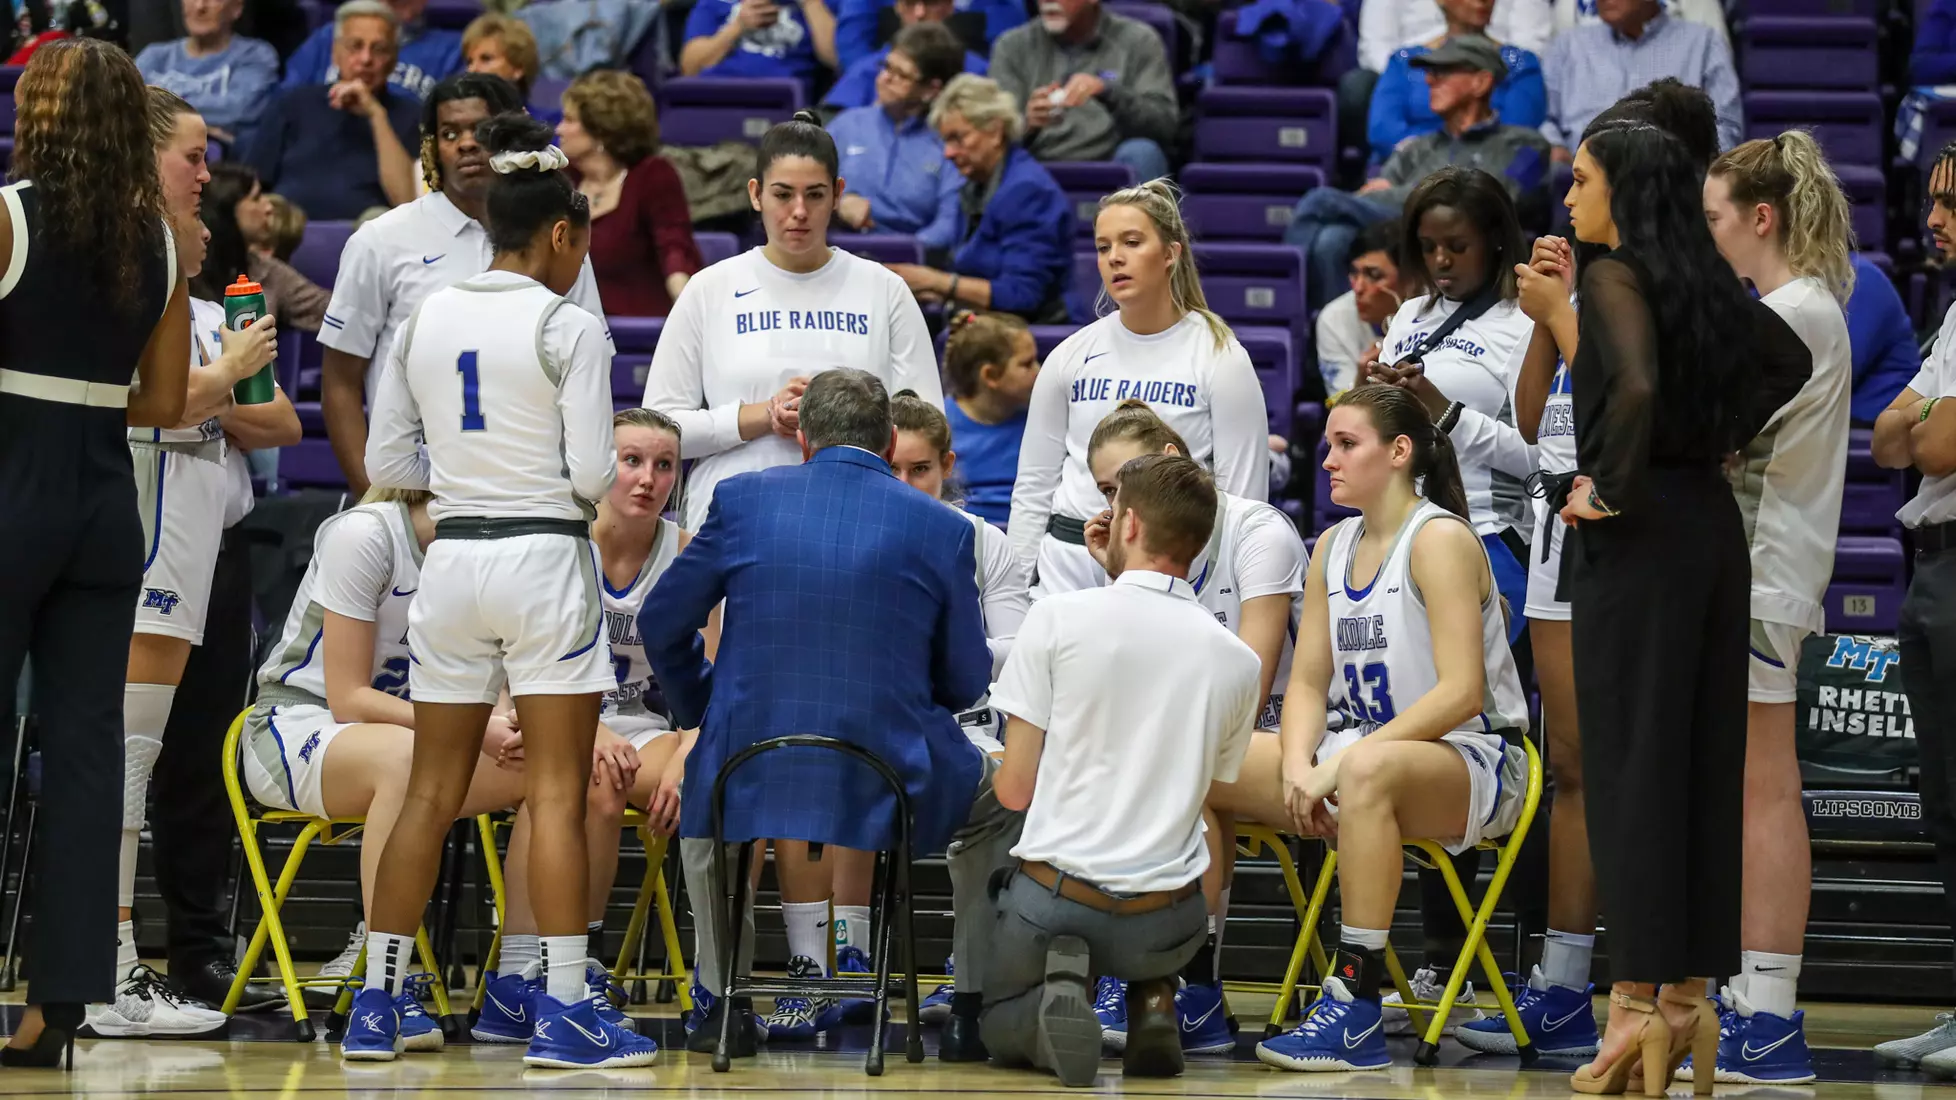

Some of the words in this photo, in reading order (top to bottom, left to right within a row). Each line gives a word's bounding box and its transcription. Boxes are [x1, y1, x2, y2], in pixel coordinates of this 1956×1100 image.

[737, 311, 781, 335] BLUE
[789, 311, 868, 335] RAIDERS
[456, 350, 487, 432] 1
[1071, 378, 1112, 402] BLUE
[1116, 379, 1197, 407] RAIDERS
[1852, 599, 1867, 613] 13
[1337, 615, 1387, 651] MIDDLE
[1826, 635, 1900, 682] MT
[1343, 661, 1396, 725] 33
[1808, 707, 1916, 739] INSELL
[1813, 800, 1922, 819] LIPSCOMB
